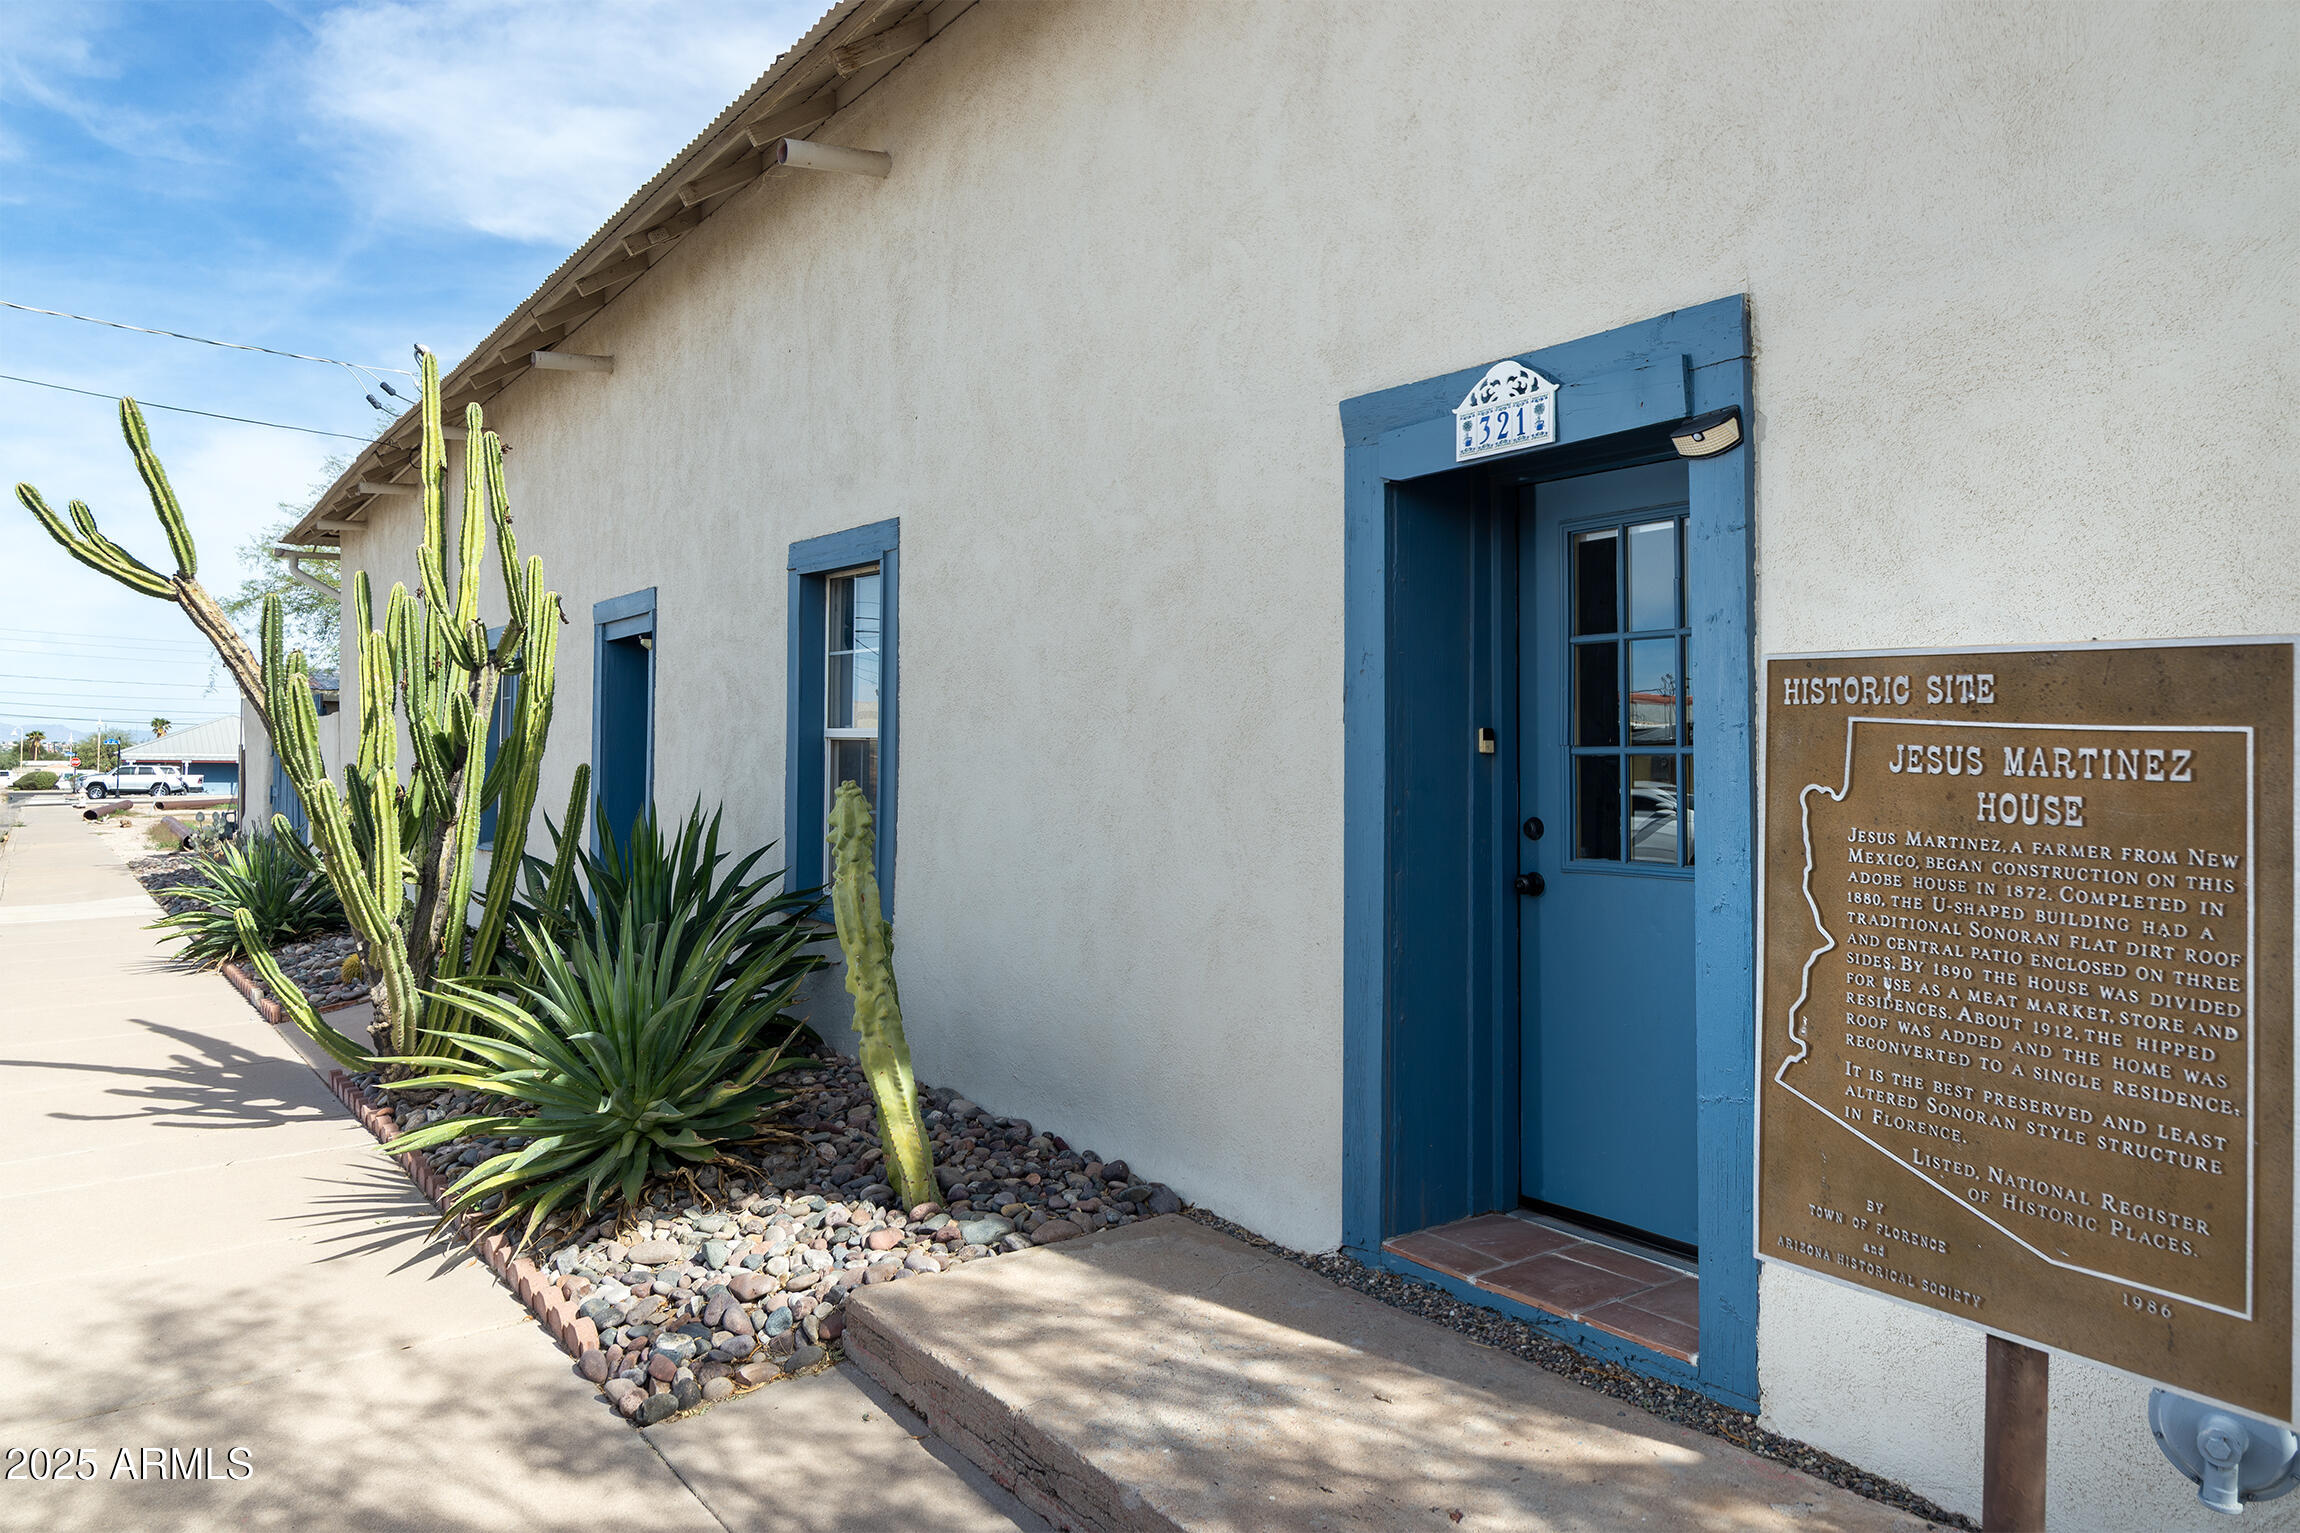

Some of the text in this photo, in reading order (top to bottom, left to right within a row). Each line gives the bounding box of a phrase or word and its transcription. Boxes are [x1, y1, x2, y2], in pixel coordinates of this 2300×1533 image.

[1478, 407, 1526, 445] 321
[1784, 673, 1995, 705] HISTORIC SITE
[1889, 744, 2192, 783] JESUS MARTINEZ
[1976, 792, 2084, 828] HOUSE
[1848, 827, 1896, 845] JESUS
[2011, 842, 2023, 854] A
[2032, 842, 2112, 860] FARMER
[2121, 848, 2178, 865] FROM
[2188, 848, 2239, 869] NEW
[1848, 872, 2224, 917] ADOBE HOUSE IN 1872. COMPLETED IN
[1925, 857, 1982, 873] BEGAN
[1992, 862, 2138, 885] CONSTRUCTION
[2147, 873, 2175, 888] ON
[2185, 876, 2235, 893] THIS
[1847, 912, 2242, 967] TRADITIONAL SONORAN FLAT DIRT ROOF
[1891, 896, 1923, 910] THE
[1933, 897, 2024, 920] U-SHAPED
[2035, 910, 2129, 932] BUILDING
[2142, 921, 2188, 938] HAD
[2200, 928, 2214, 941] A
[1848, 934, 2241, 992] AND CENTRAL PATIO ENCLOSED ON THREE
[1900, 956, 1924, 973] BY
[1933, 963, 1972, 980] 1890
[1983, 970, 2017, 986] THE
[2028, 976, 2089, 996] HOUSE
[2099, 986, 2139, 1004] WAS
[2151, 993, 2241, 1017] DIVIDED
[1846, 973, 1875, 988] FOR
[1883, 977, 1911, 992] USE
[1919, 983, 1940, 997] AS
[1948, 987, 1960, 1000] A
[1968, 989, 2017, 1008] MEAT
[2119, 1011, 2185, 1034] STORE
[2192, 1023, 2239, 1041] AND
[1846, 1013, 2227, 1088] ROOF WAS ADDED AND THE HOME WAS
[1957, 1006, 2022, 1031] ABOUT
[2084, 1029, 2123, 1047] THE
[2136, 1037, 2216, 1062] HIPPED
[1846, 1034, 1970, 1067] RECONVERTED
[1979, 1057, 2003, 1073] TO
[2012, 1064, 2024, 1077] A
[2033, 1067, 2102, 1091] SINGLE
[1845, 1061, 2227, 1151] IT IS THE BEST PRESERVED AND LEAST
[1845, 1106, 1967, 1144] IN FLORENCE.
[1845, 1085, 2222, 1175] ALTERED SONORAN STYLE STRUCTURE
[1867, 1200, 1885, 1215] BY
[1968, 1188, 2199, 1257] OF HISTORIC PLACES.
[1988, 1166, 2091, 1206] NATIONAL
[2100, 1192, 2210, 1236] REGISTER
[1808, 1203, 1946, 1254] TOWN OF FLORENCE
[1863, 1243, 1885, 1257] and
[1777, 1234, 1982, 1308] ARIZONA HISTORICAL SOCIETY
[2122, 1293, 2172, 1318] 1986
